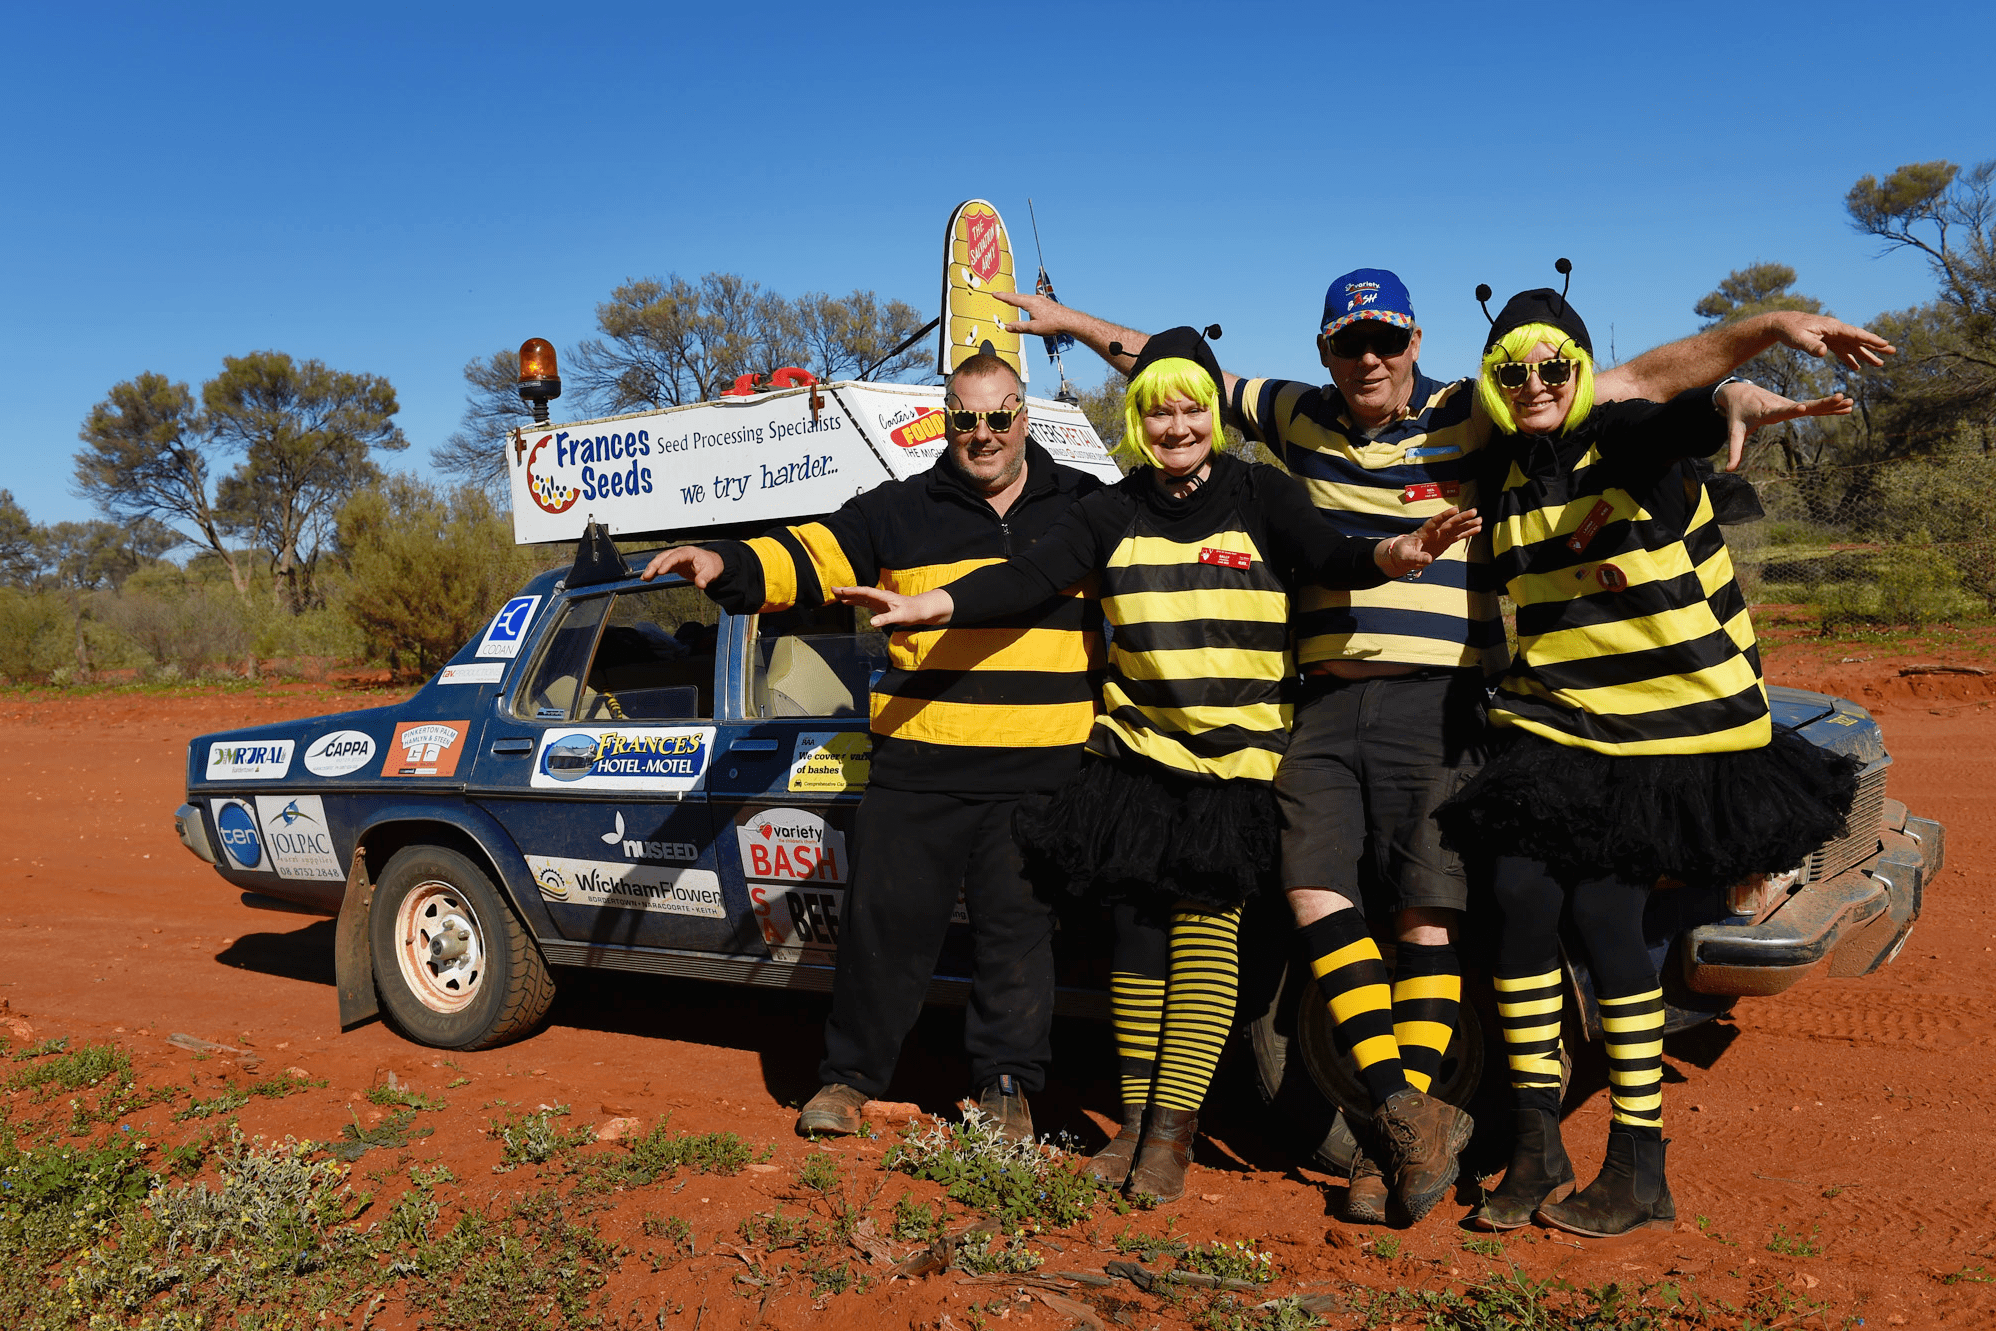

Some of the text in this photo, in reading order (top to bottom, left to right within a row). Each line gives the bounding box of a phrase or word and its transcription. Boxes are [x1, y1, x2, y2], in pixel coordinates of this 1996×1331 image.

[972, 219, 984, 240] THE
[970, 223, 995, 265] SALVATION
[982, 243, 995, 274] ARMY
[1355, 281, 1380, 289] variety
[1347, 292, 1377, 311] BASH
[879, 404, 915, 429] Carter's
[657, 414, 842, 454] Seed Processing Specialists
[902, 412, 945, 445] FOOD
[1027, 422, 1102, 449] RTERS RETAIL
[556, 430, 650, 467] Frances
[903, 448, 944, 458] THE MIGH
[582, 460, 653, 500] Seeds
[680, 454, 838, 505] we try harder...
[483, 645, 514, 655] CODAN
[404, 726, 456, 739] PINKERTON PALM
[405, 735, 428, 746] HAMLYN
[325, 741, 368, 757] CAPPA
[593, 732, 703, 762] FRANCES
[799, 751, 812, 760] We
[597, 759, 694, 774] HOTEL-MOTEL
[797, 765, 839, 774] of bashes
[220, 827, 260, 845] ten
[774, 825, 822, 842] variety
[270, 834, 329, 860] JOLPAC
[750, 844, 838, 880] BASH
[280, 868, 339, 877] 08 8752 2848
[588, 896, 718, 915] BORDERTOWN NARACOORTE KEITH
[785, 892, 839, 944] BEE
[952, 911, 967, 920] ing
